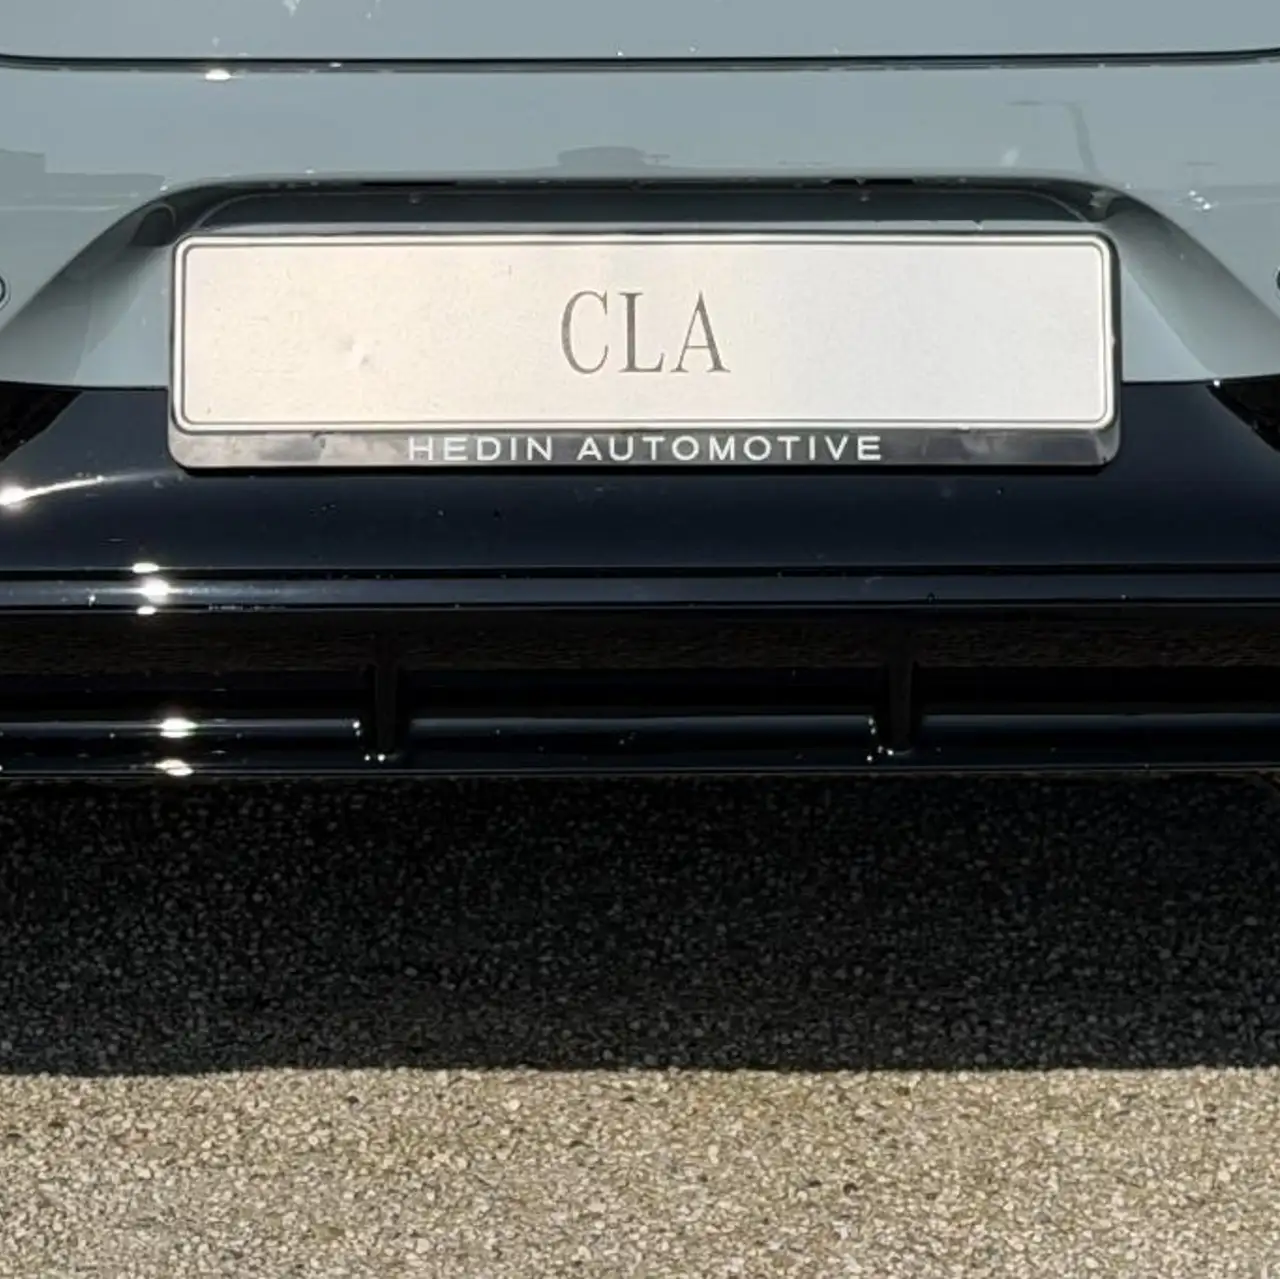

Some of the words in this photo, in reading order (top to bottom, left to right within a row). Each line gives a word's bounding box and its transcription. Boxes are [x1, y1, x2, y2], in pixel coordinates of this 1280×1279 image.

[560, 289, 732, 375] CLA
[407, 435, 554, 463] HEDIN
[576, 434, 884, 463] AUTOMOTIVE
